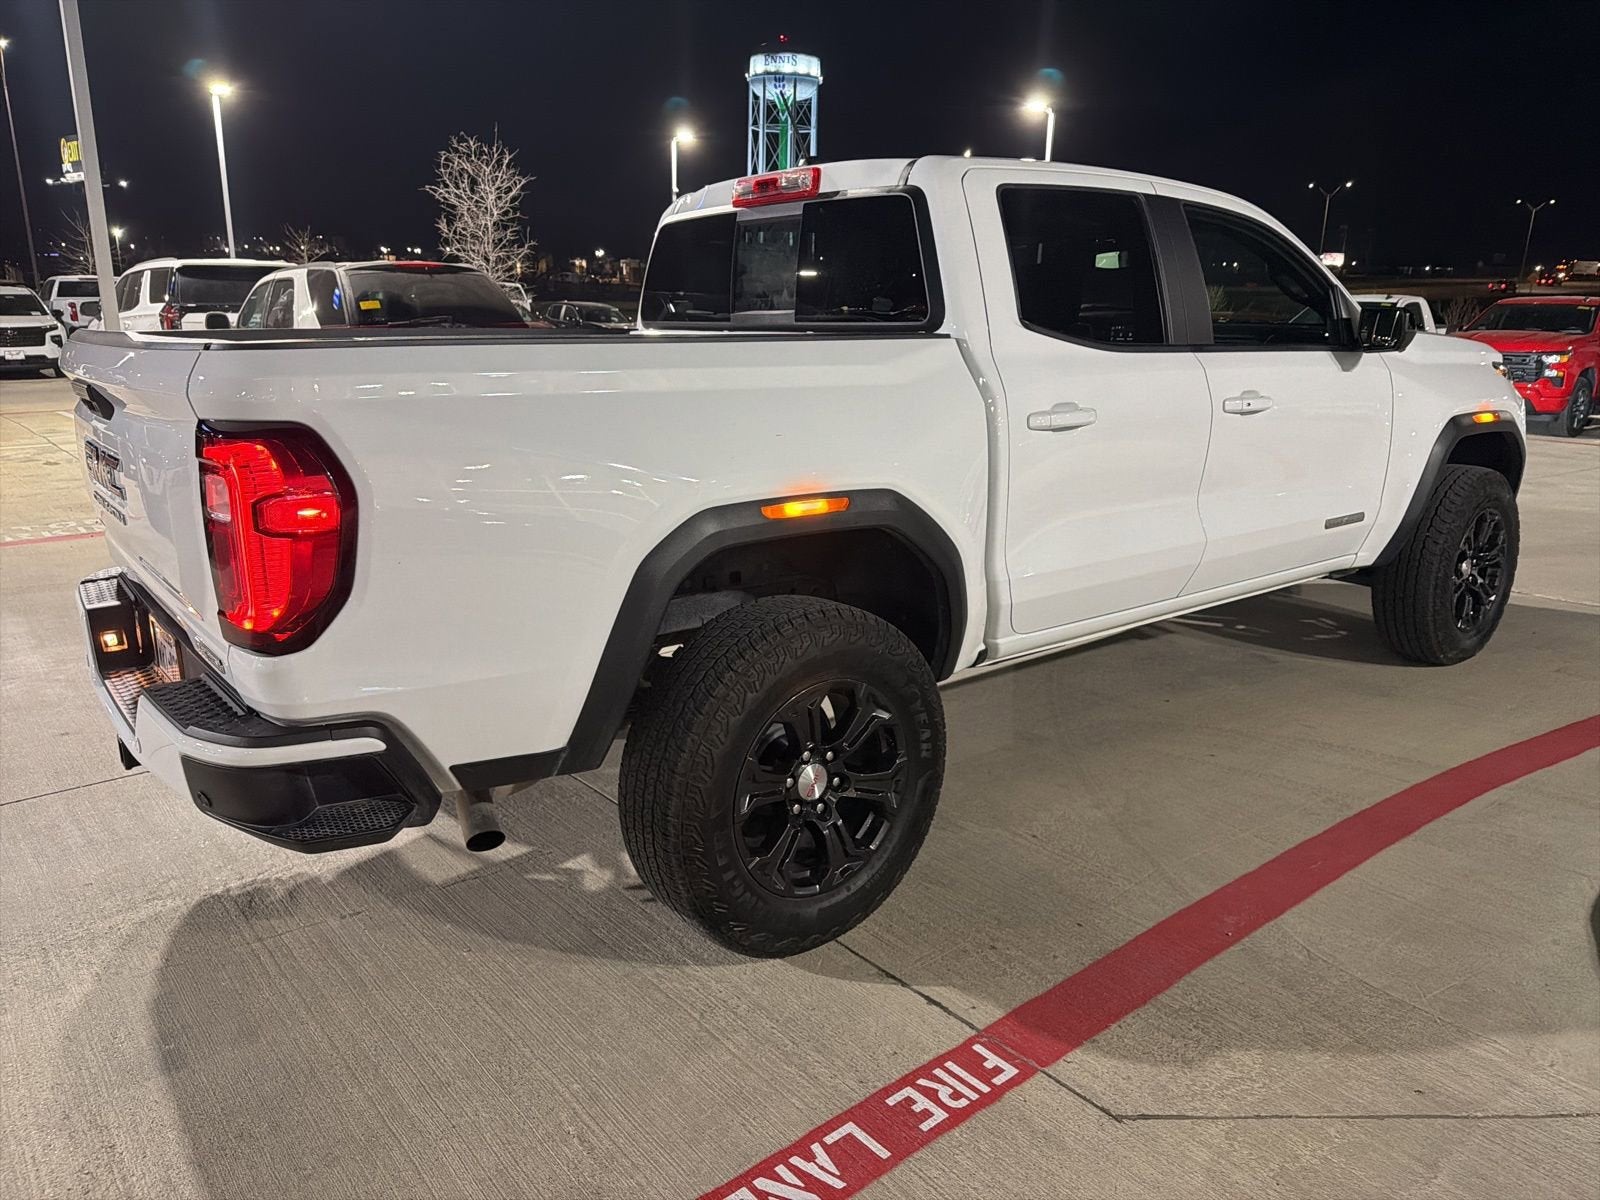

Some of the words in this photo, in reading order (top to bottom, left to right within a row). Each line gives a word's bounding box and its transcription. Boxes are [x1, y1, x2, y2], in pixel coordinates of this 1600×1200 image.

[764, 54, 798, 67] ENNIS
[884, 1043, 1020, 1132] FIRE
[722, 1121, 892, 1200] LAN
